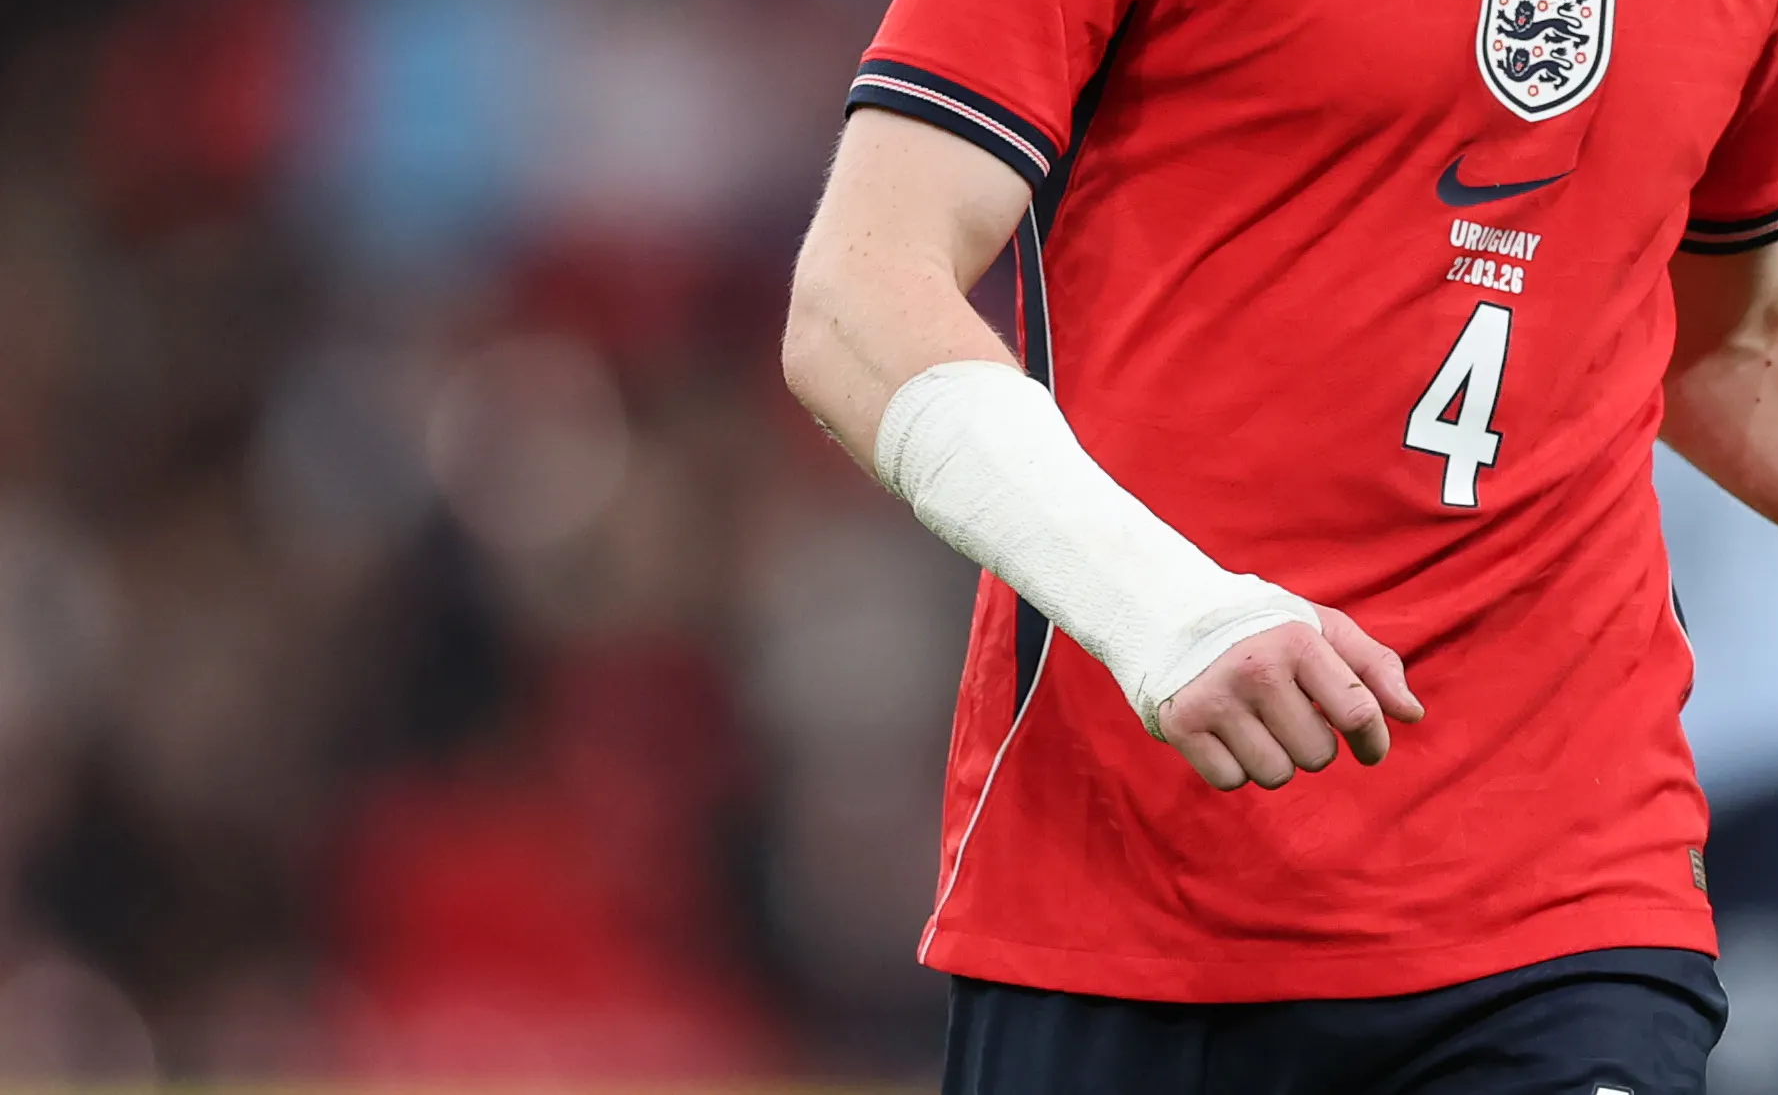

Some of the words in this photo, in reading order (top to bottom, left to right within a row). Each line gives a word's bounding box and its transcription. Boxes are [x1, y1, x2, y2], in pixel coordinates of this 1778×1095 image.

[1449, 218, 1542, 261] URUGUAY
[1446, 256, 1525, 294] 27.03.26
[1403, 300, 1513, 508] 4
